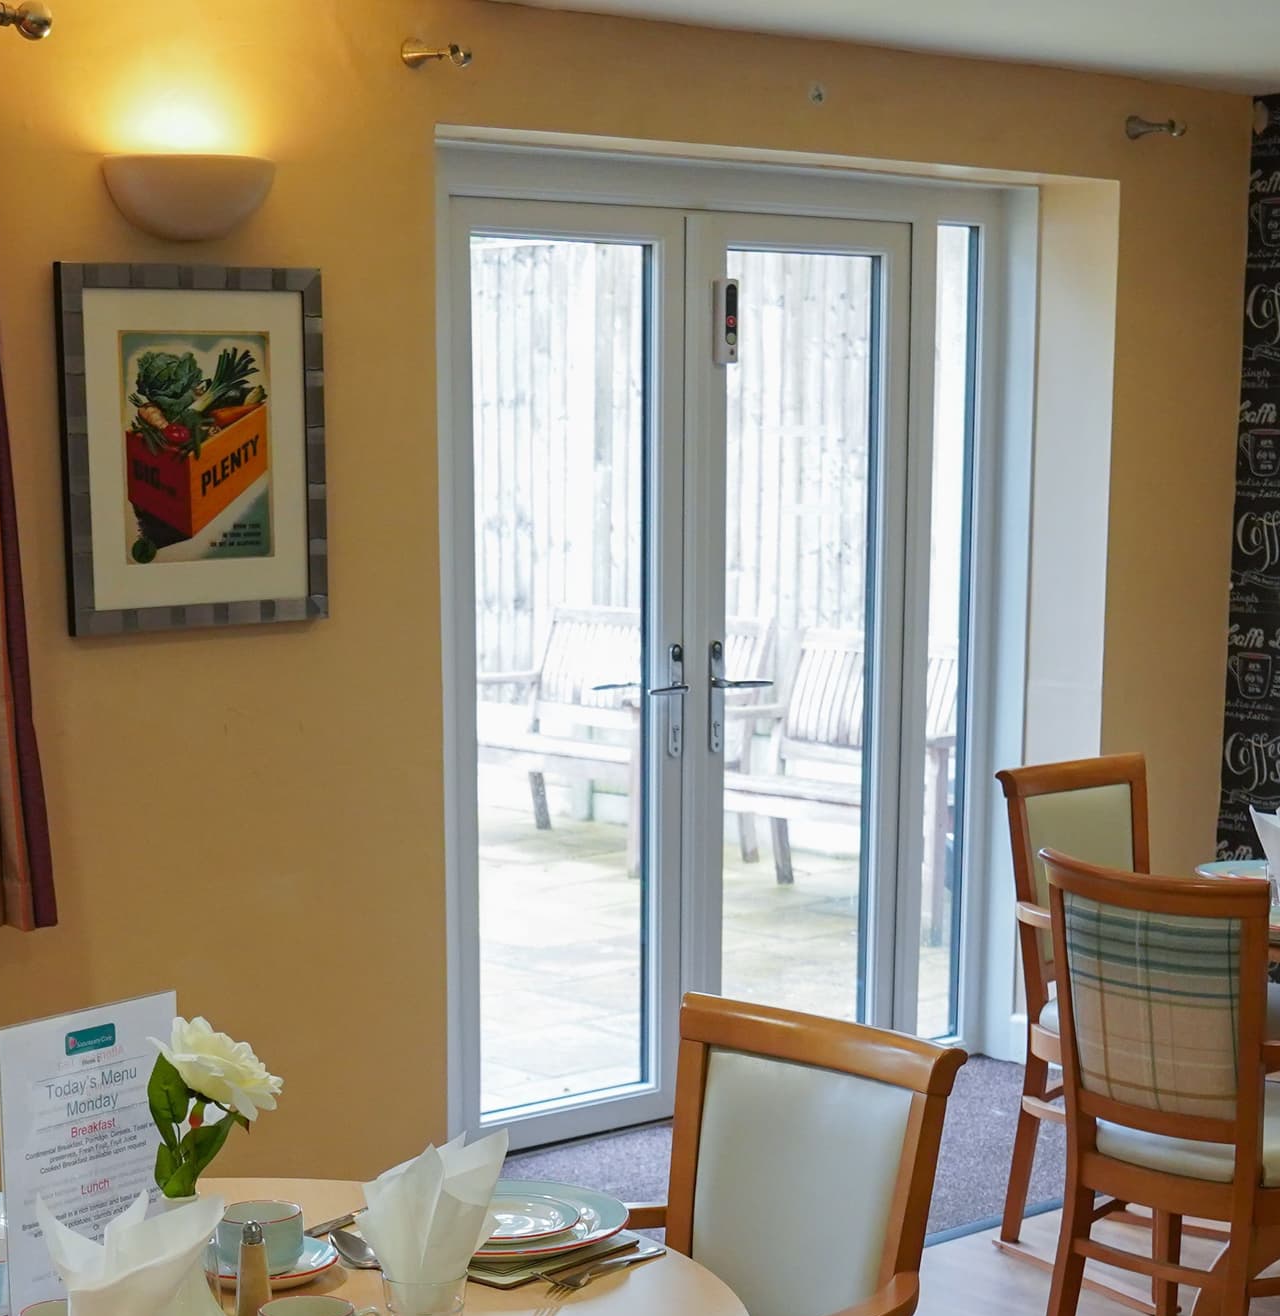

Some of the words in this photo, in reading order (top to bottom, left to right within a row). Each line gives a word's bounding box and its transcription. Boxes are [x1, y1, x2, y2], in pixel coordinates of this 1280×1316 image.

[201, 434, 260, 497] PLENTY
[46, 1074, 96, 1099] Today's
[101, 1067, 137, 1086] Menu
[67, 1093, 119, 1117] Monday
[71, 1117, 116, 1138] Breakfast
[39, 1164, 61, 1175] Cooked
[81, 1178, 110, 1195] Lunch
